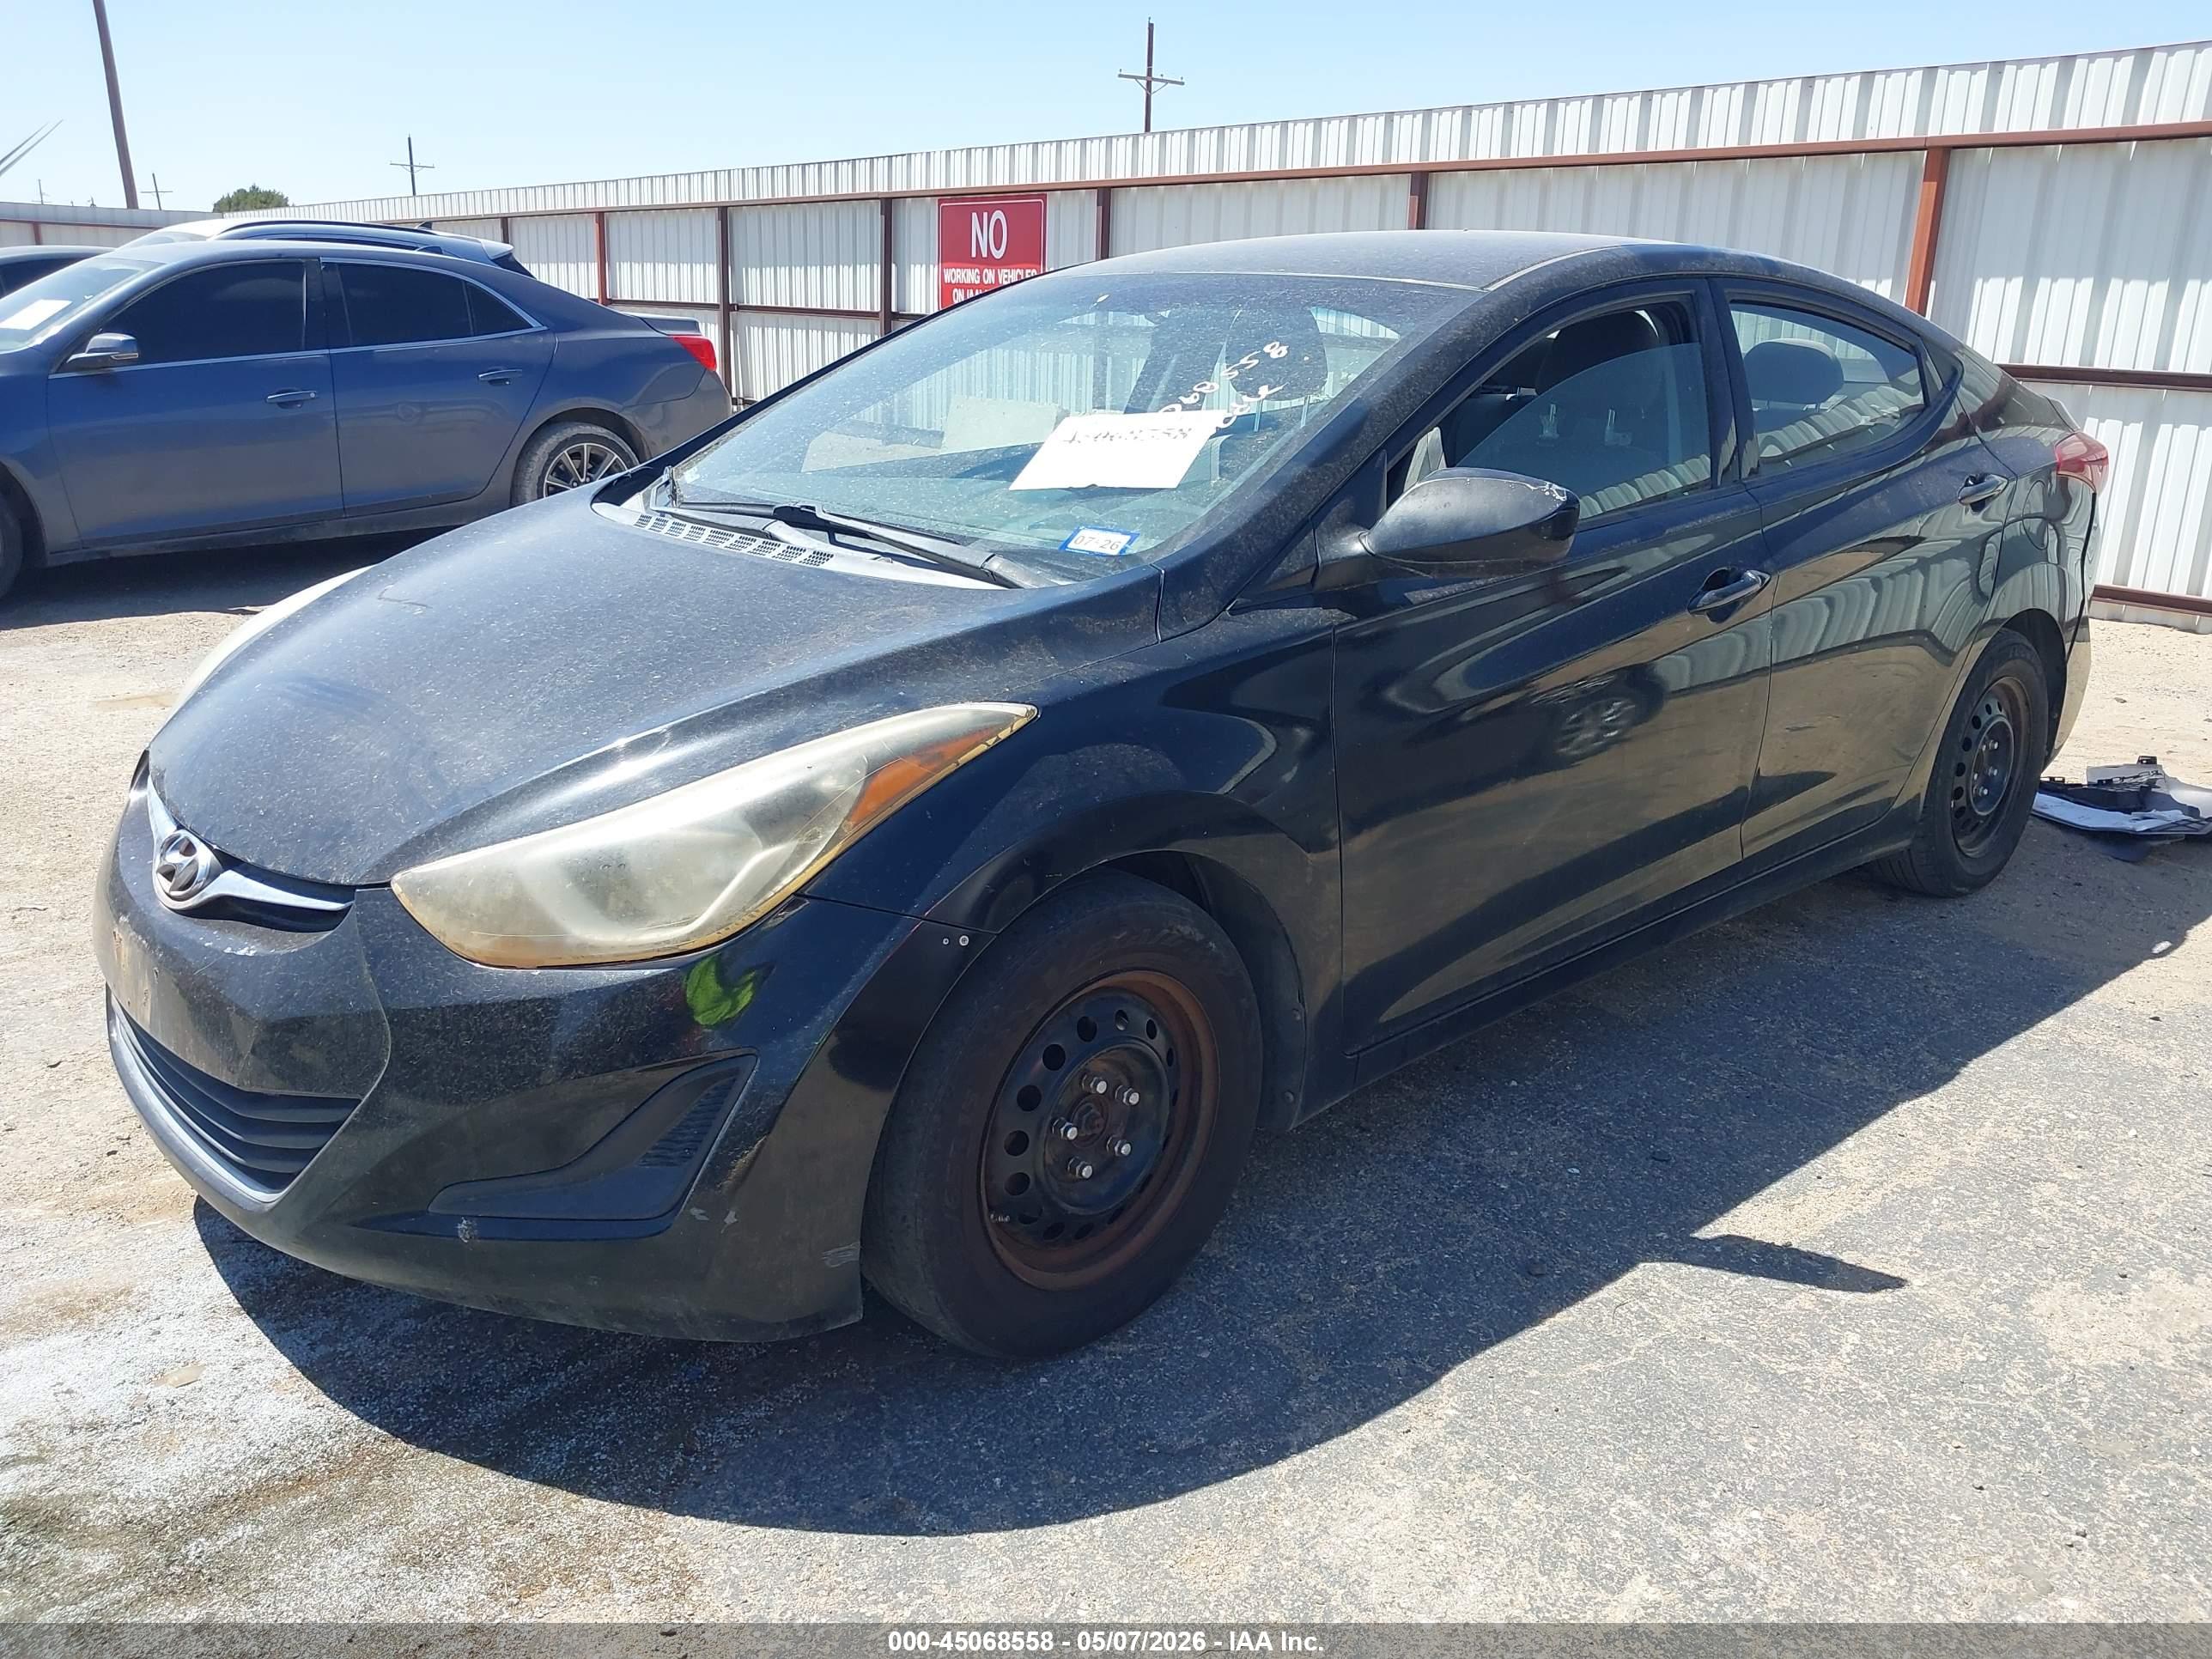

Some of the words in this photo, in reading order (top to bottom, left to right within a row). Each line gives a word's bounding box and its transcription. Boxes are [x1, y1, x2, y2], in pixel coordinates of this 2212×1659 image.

[971, 210, 1008, 259] NO
[943, 267, 981, 284] WORKING
[982, 268, 995, 284] ON
[952, 288, 965, 304] ON
